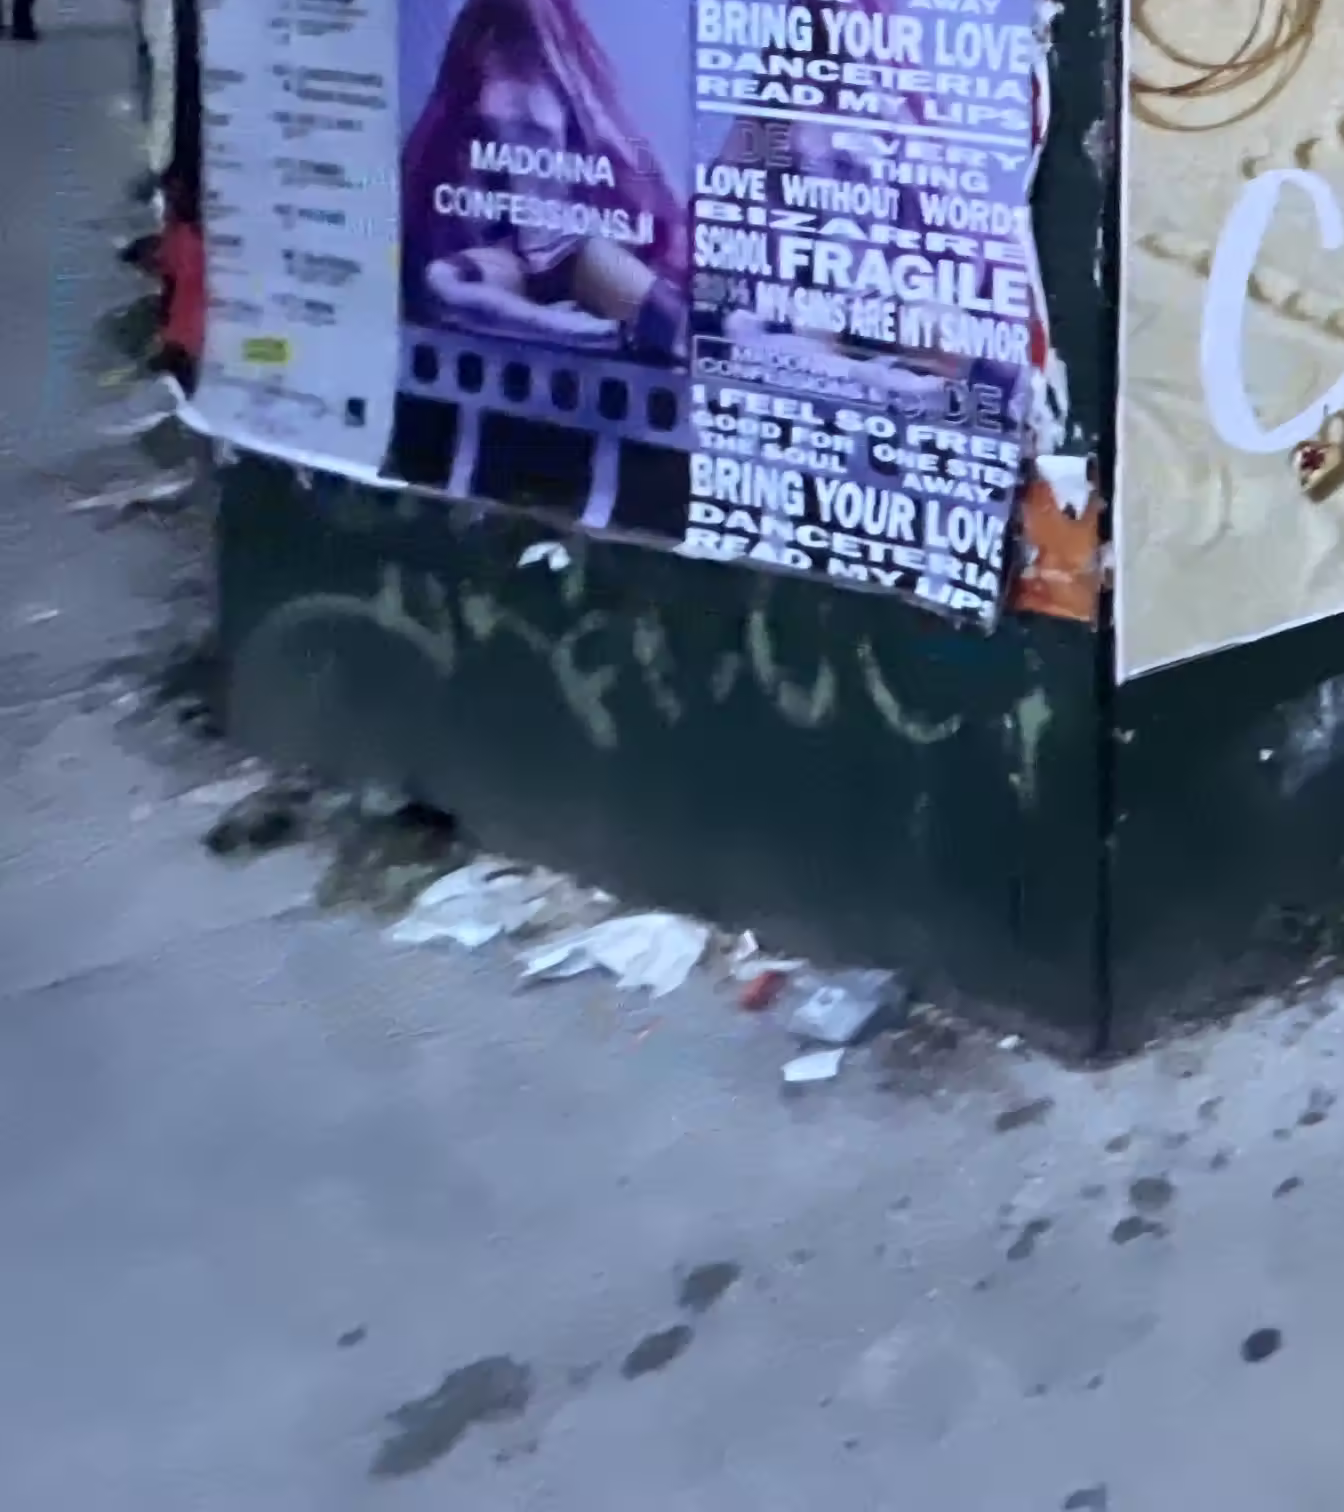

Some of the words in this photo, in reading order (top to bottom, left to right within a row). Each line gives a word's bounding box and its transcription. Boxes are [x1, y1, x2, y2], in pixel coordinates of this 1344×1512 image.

[820, 7, 924, 65] YOUR
[934, 18, 1034, 75] LOVE
[696, 48, 1029, 101] DANCETERIA
[696, 74, 825, 107] READ
[838, 89, 908, 115] MY
[922, 99, 1030, 131] LIPS
[470, 139, 615, 188] MADONNA
[831, 131, 1028, 171] EVERY
[869, 156, 990, 194] THING
[696, 163, 767, 202] LOVE
[781, 173, 901, 220] WITHOUT
[695, 200, 1028, 264] BIZARRE
[778, 235, 1032, 319] FRAGILE
[851, 296, 897, 342] ARE
[899, 304, 939, 350] MY
[940, 312, 1030, 367] SAVIOR
[719, 388, 825, 428] FEEL
[834, 409, 897, 438] SO
[906, 424, 1020, 468] FREE
[791, 426, 855, 455] FOR
[762, 443, 848, 474] SOUL
[872, 443, 940, 472] ONE
[689, 452, 805, 518] BRING
[813, 477, 916, 542] YOUR
[902, 472, 995, 503] AWAY
[683, 527, 813, 570] READ
[827, 558, 904, 588] MY
[687, 501, 1000, 598] DANCETERIA
